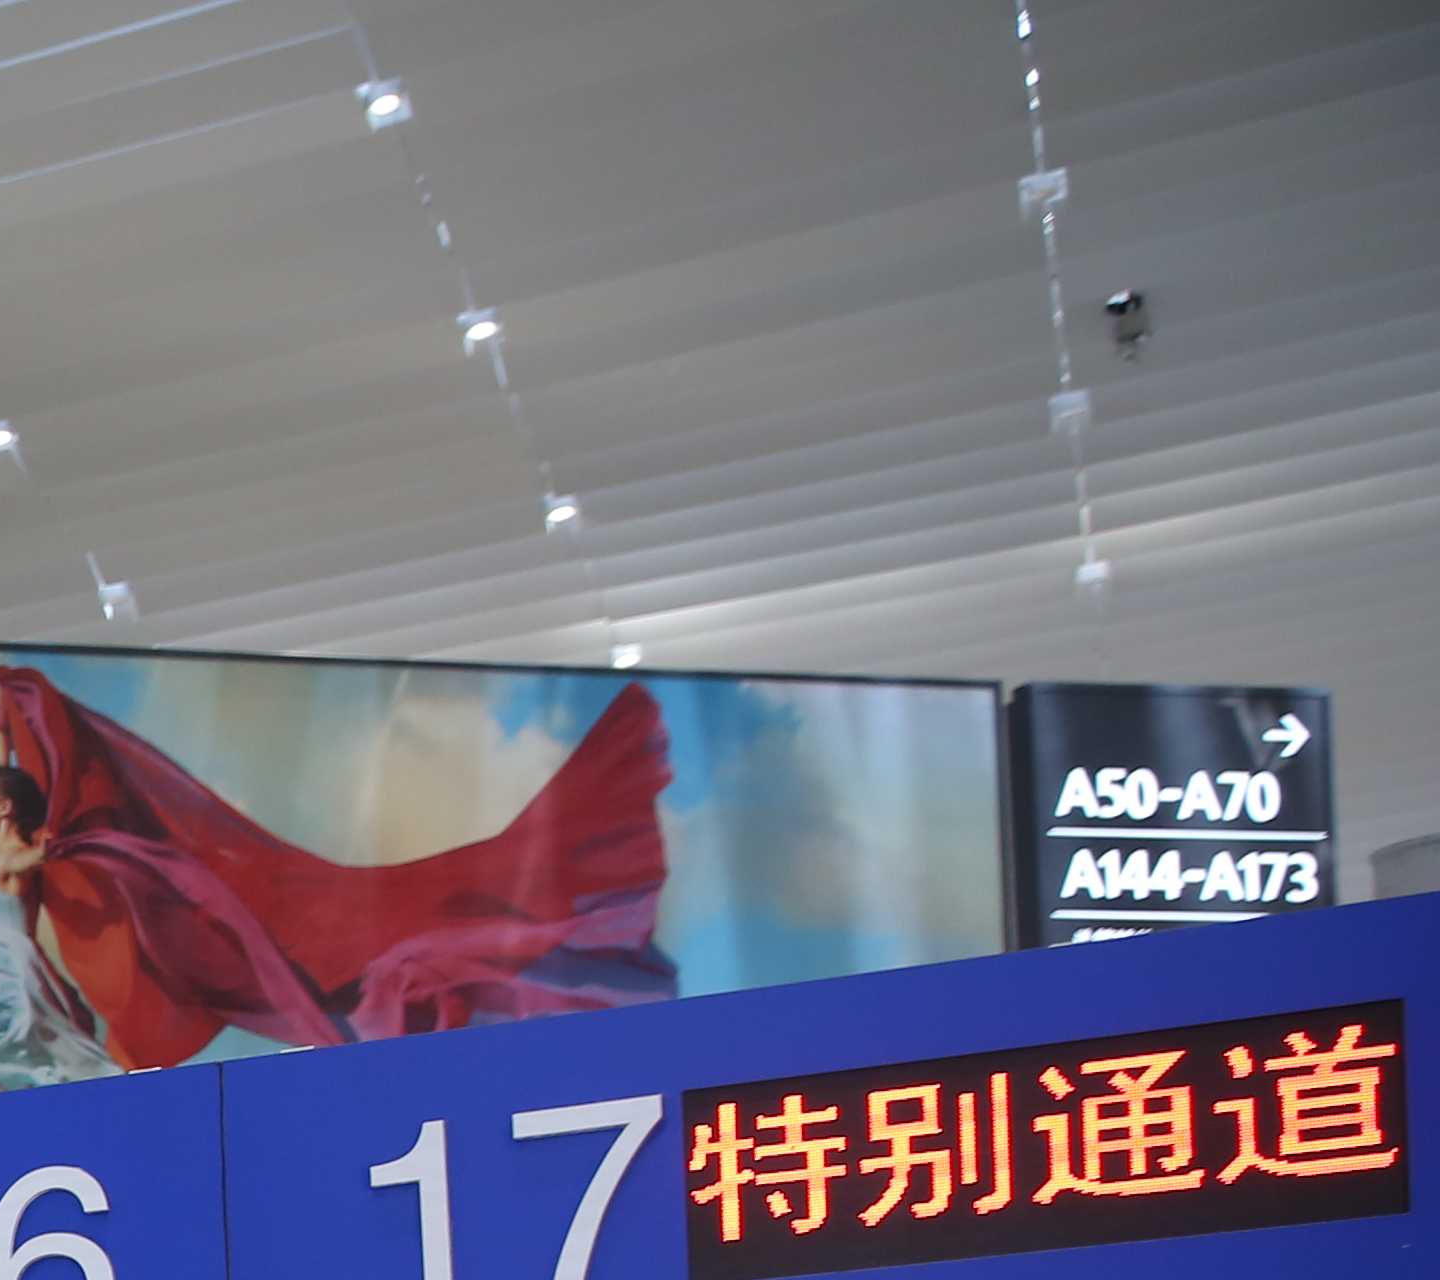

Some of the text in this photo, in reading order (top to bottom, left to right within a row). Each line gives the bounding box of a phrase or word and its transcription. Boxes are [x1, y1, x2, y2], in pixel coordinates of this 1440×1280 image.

[1054, 766, 1281, 823] A50-A70
[1059, 848, 1320, 904] A144-A173
[687, 1022, 1400, 1243] 特别通道
